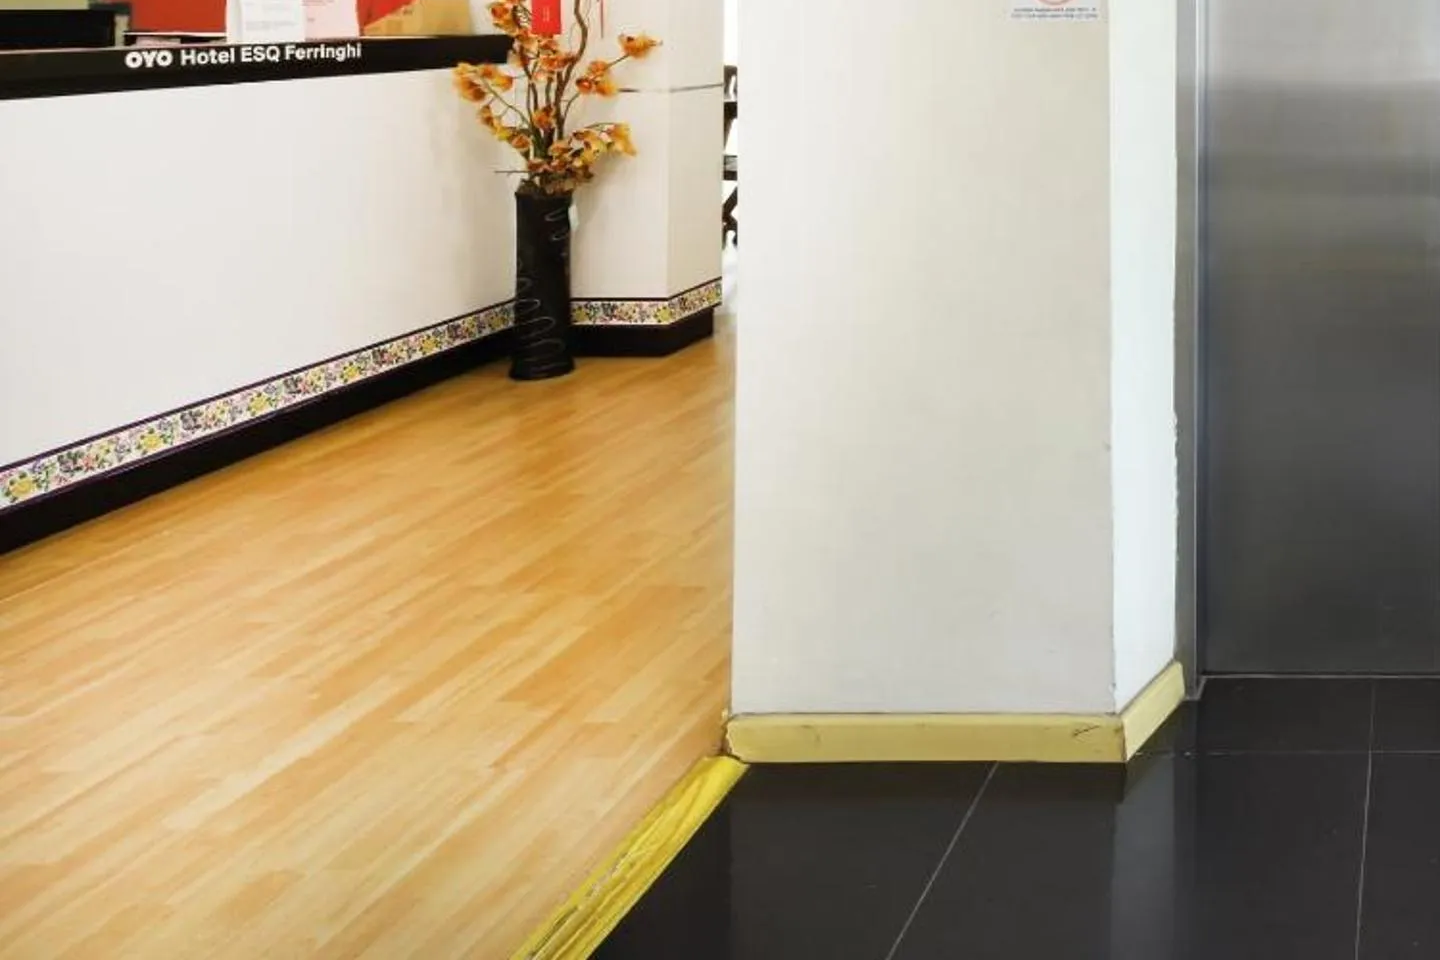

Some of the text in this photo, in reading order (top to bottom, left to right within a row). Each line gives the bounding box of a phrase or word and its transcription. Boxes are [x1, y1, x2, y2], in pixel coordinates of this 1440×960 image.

[125, 43, 363, 69] OYO Hotel ESQ Ferringhi
